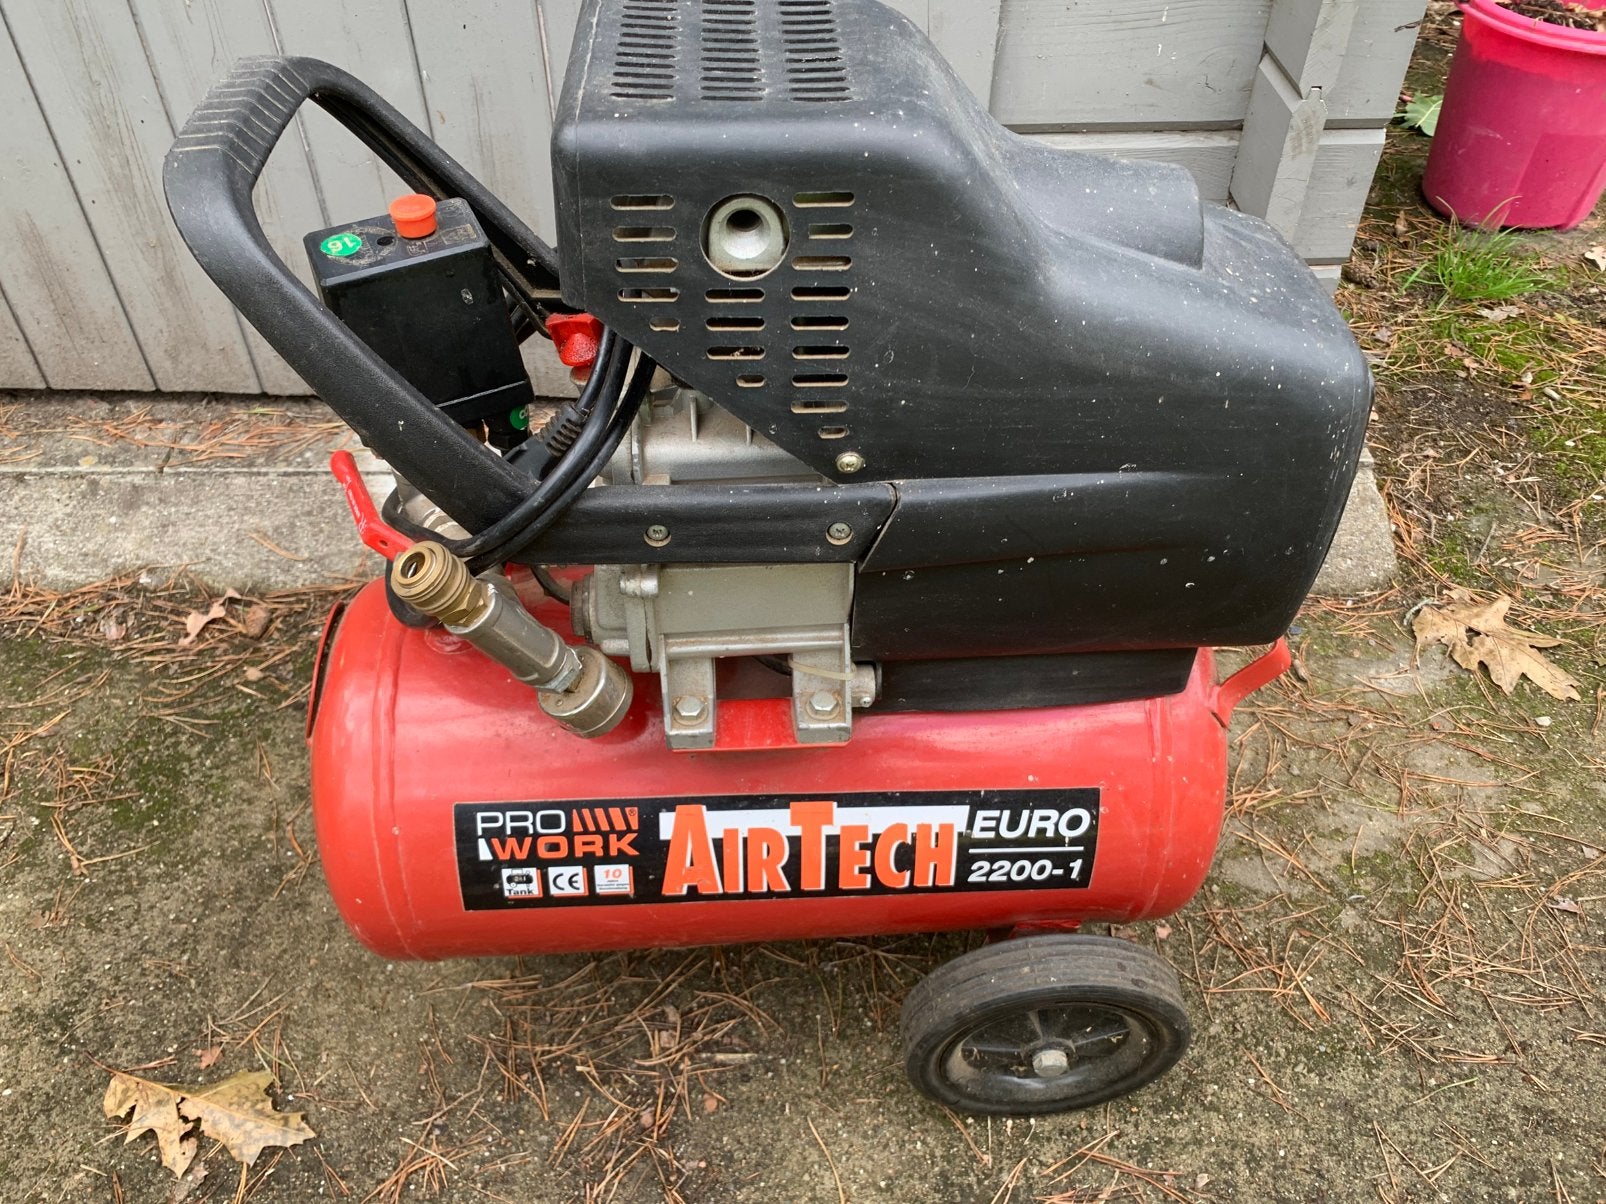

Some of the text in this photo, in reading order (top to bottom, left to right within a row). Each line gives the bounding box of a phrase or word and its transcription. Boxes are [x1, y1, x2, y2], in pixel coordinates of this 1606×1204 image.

[327, 236, 357, 254] 16
[476, 809, 566, 836] PRO
[971, 807, 1091, 839] EURO
[491, 832, 640, 860] WORK
[603, 868, 623, 879] 10
[967, 858, 1083, 882] 2200-1
[506, 888, 535, 896] Tank
[552, 872, 580, 891] CE
